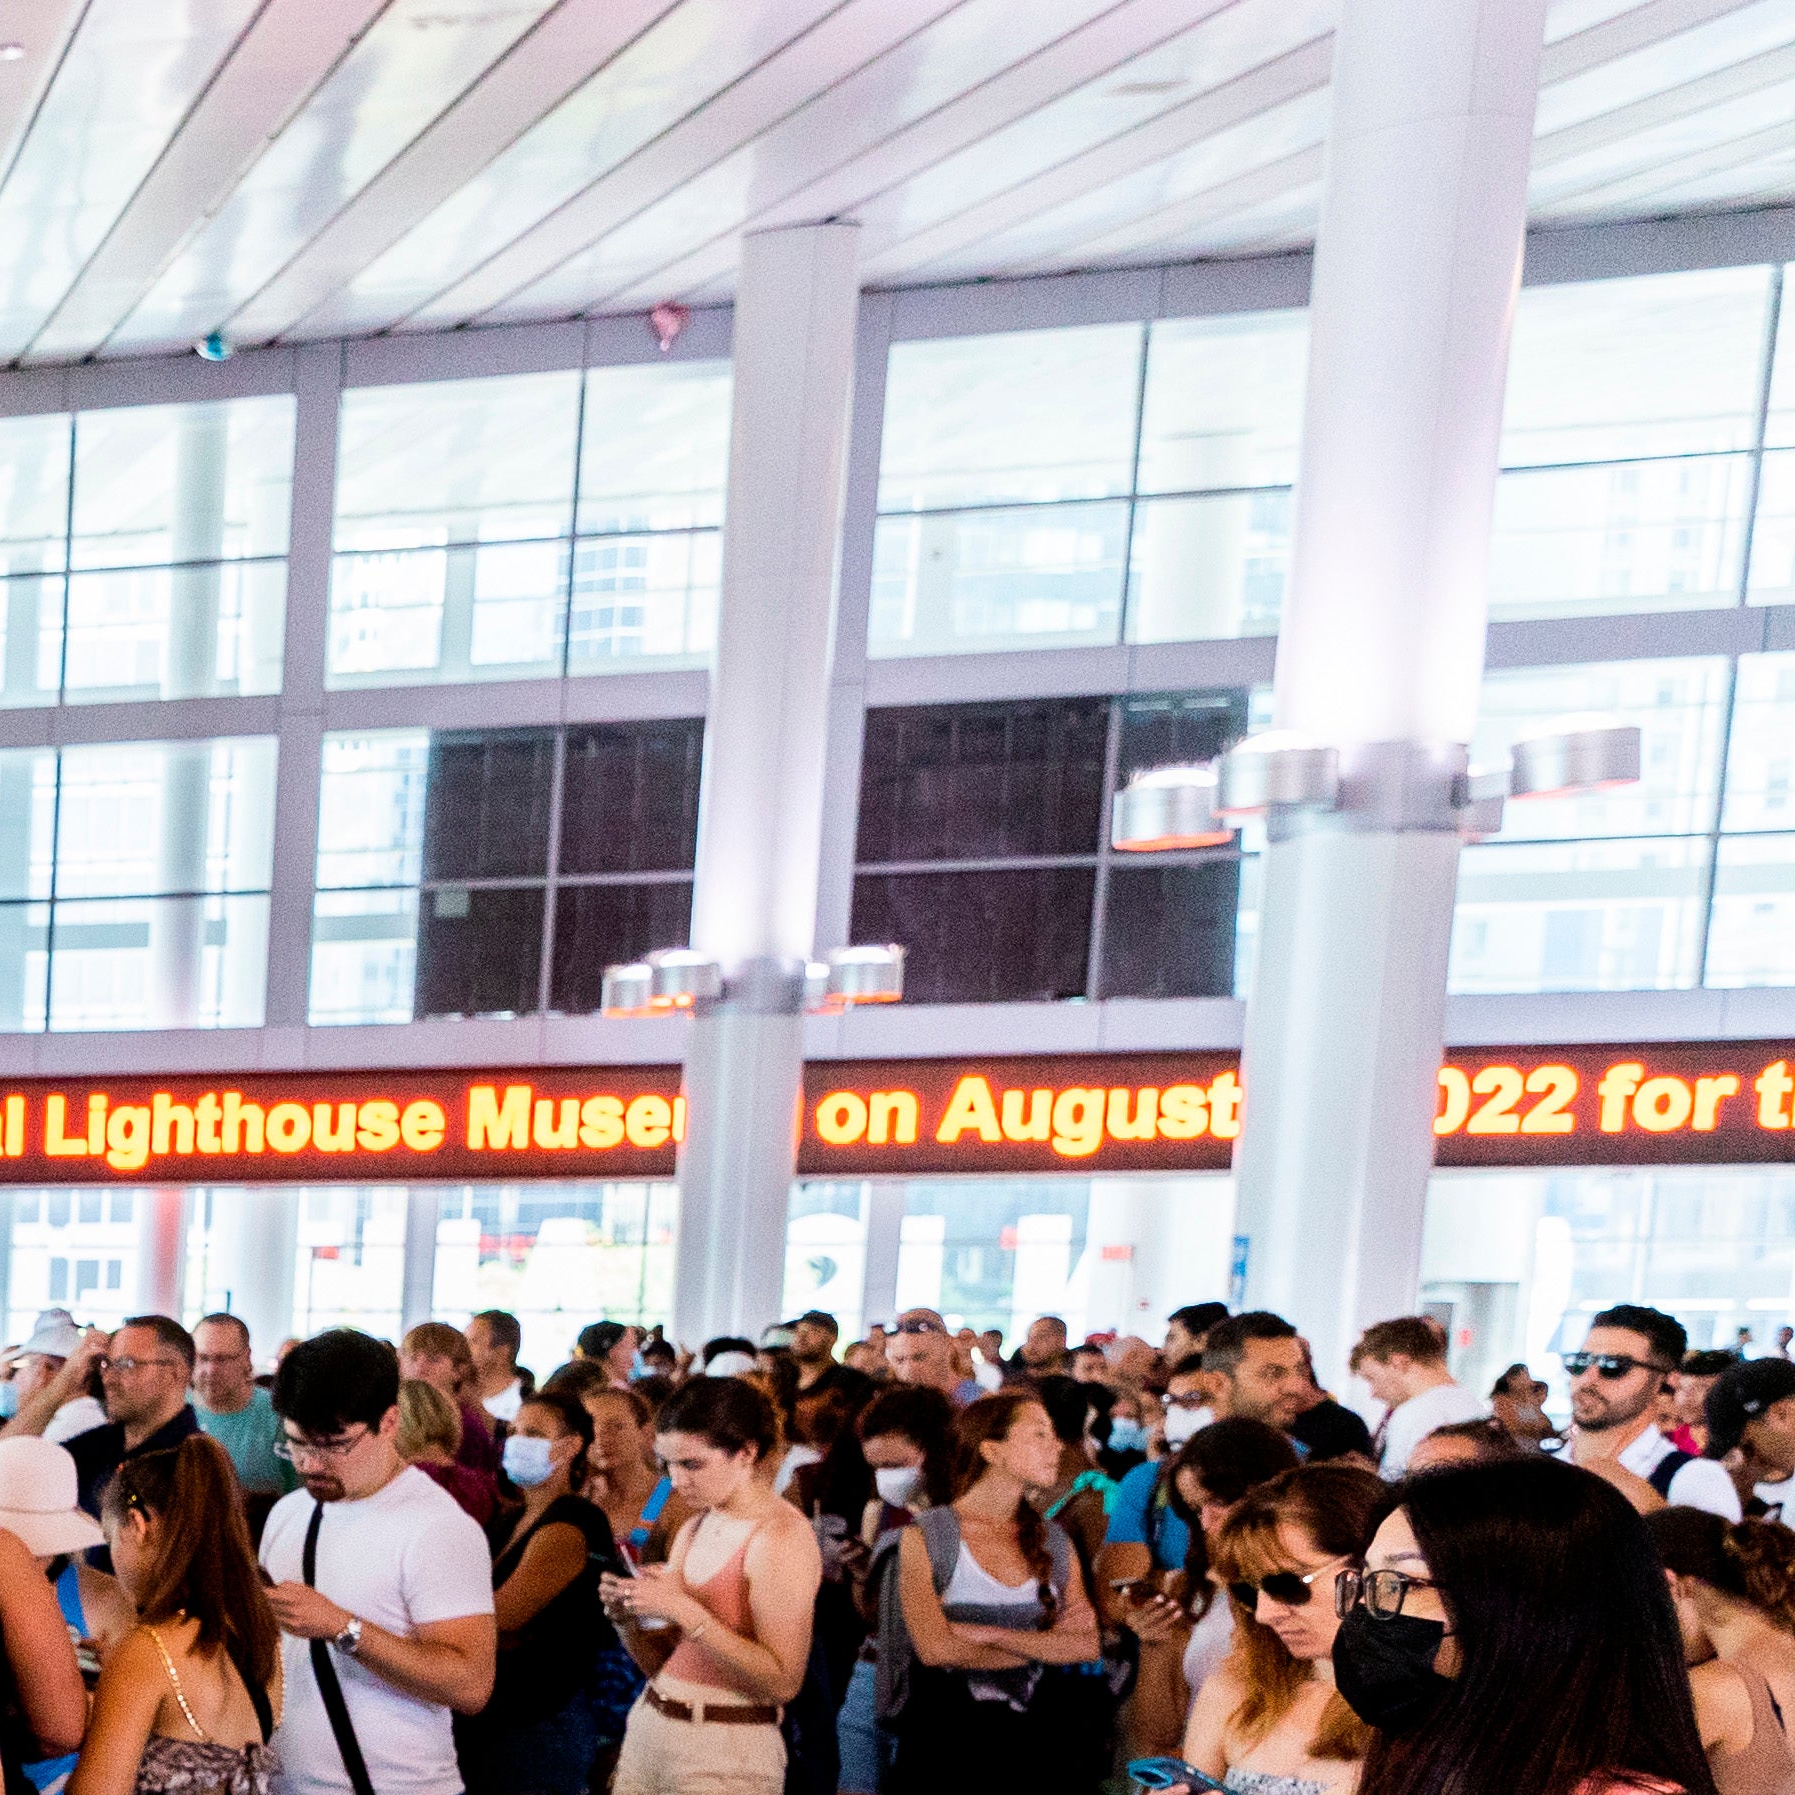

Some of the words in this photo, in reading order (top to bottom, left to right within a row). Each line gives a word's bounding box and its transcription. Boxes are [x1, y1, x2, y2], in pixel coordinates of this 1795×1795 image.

[44, 1091, 446, 1171] Lighthouse
[815, 1089, 920, 1146] on
[934, 1070, 1242, 1158] August
[1597, 1061, 1741, 1133] for
